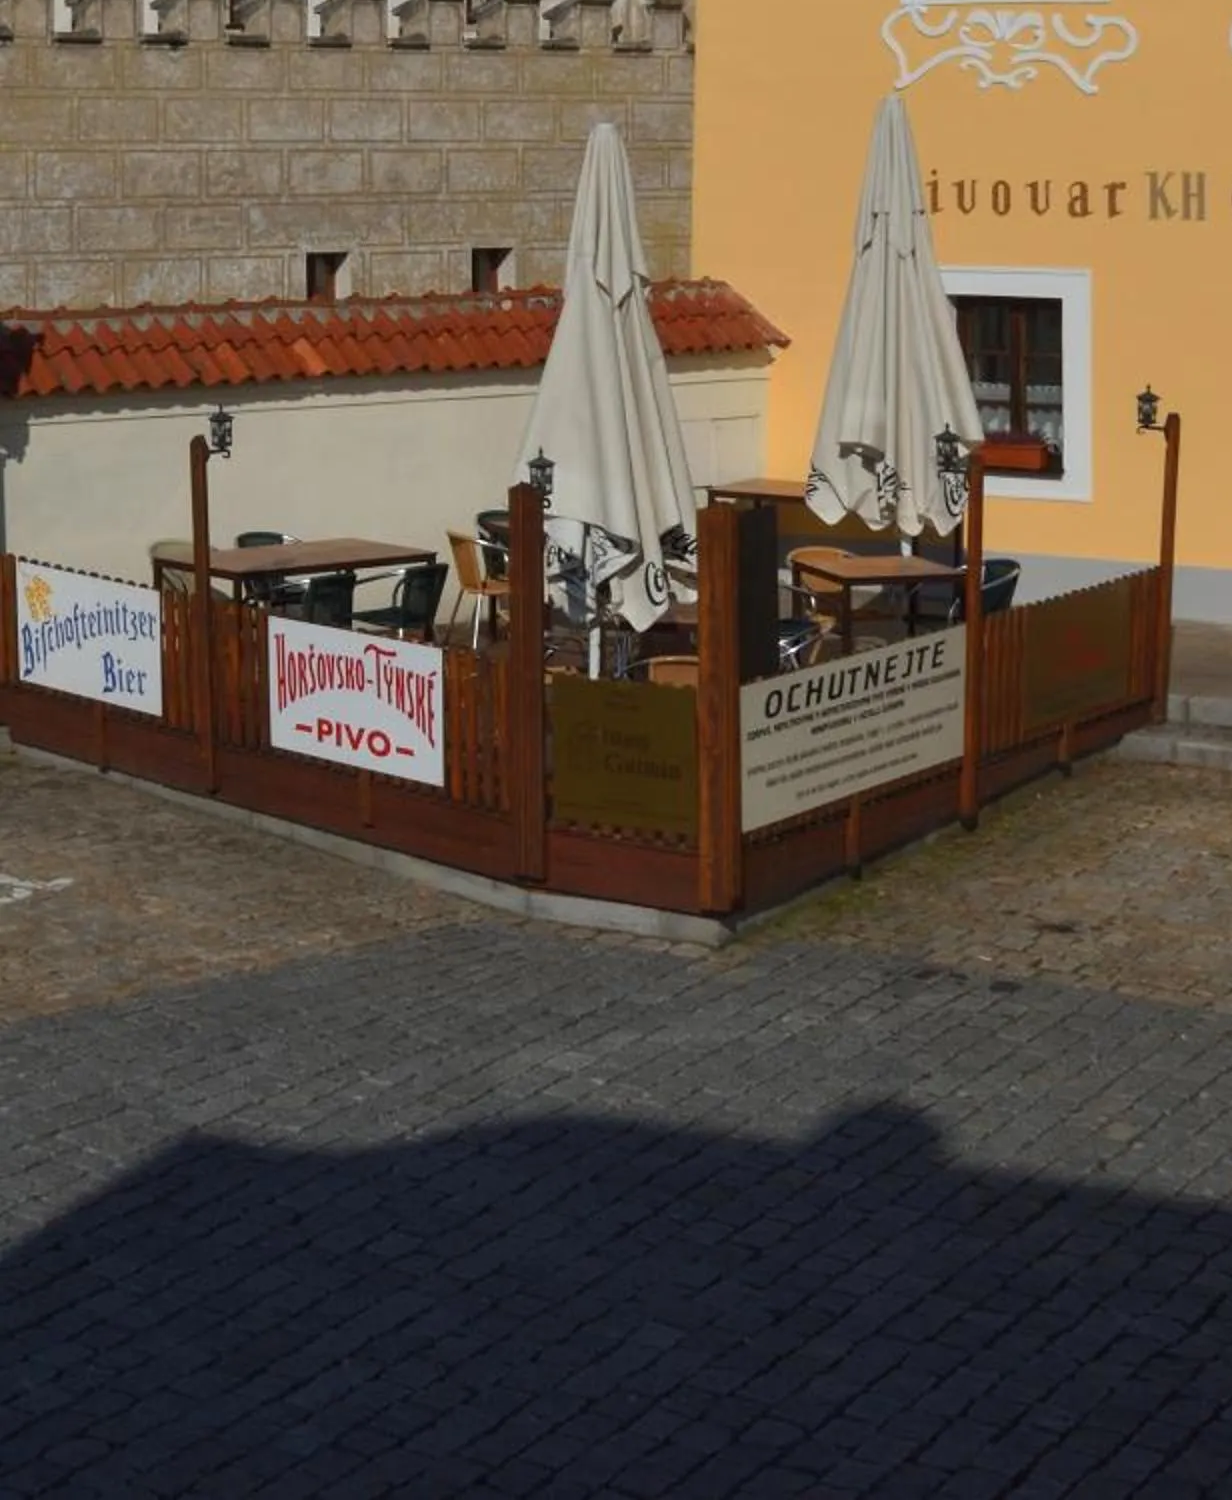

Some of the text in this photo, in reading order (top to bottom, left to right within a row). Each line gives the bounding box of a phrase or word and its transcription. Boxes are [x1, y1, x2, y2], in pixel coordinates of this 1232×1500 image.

[925, 169, 1127, 218] ivovar
[1145, 171, 1206, 221] KH
[102, 651, 147, 695] Bier
[764, 640, 946, 719] OCHUTNEJTE
